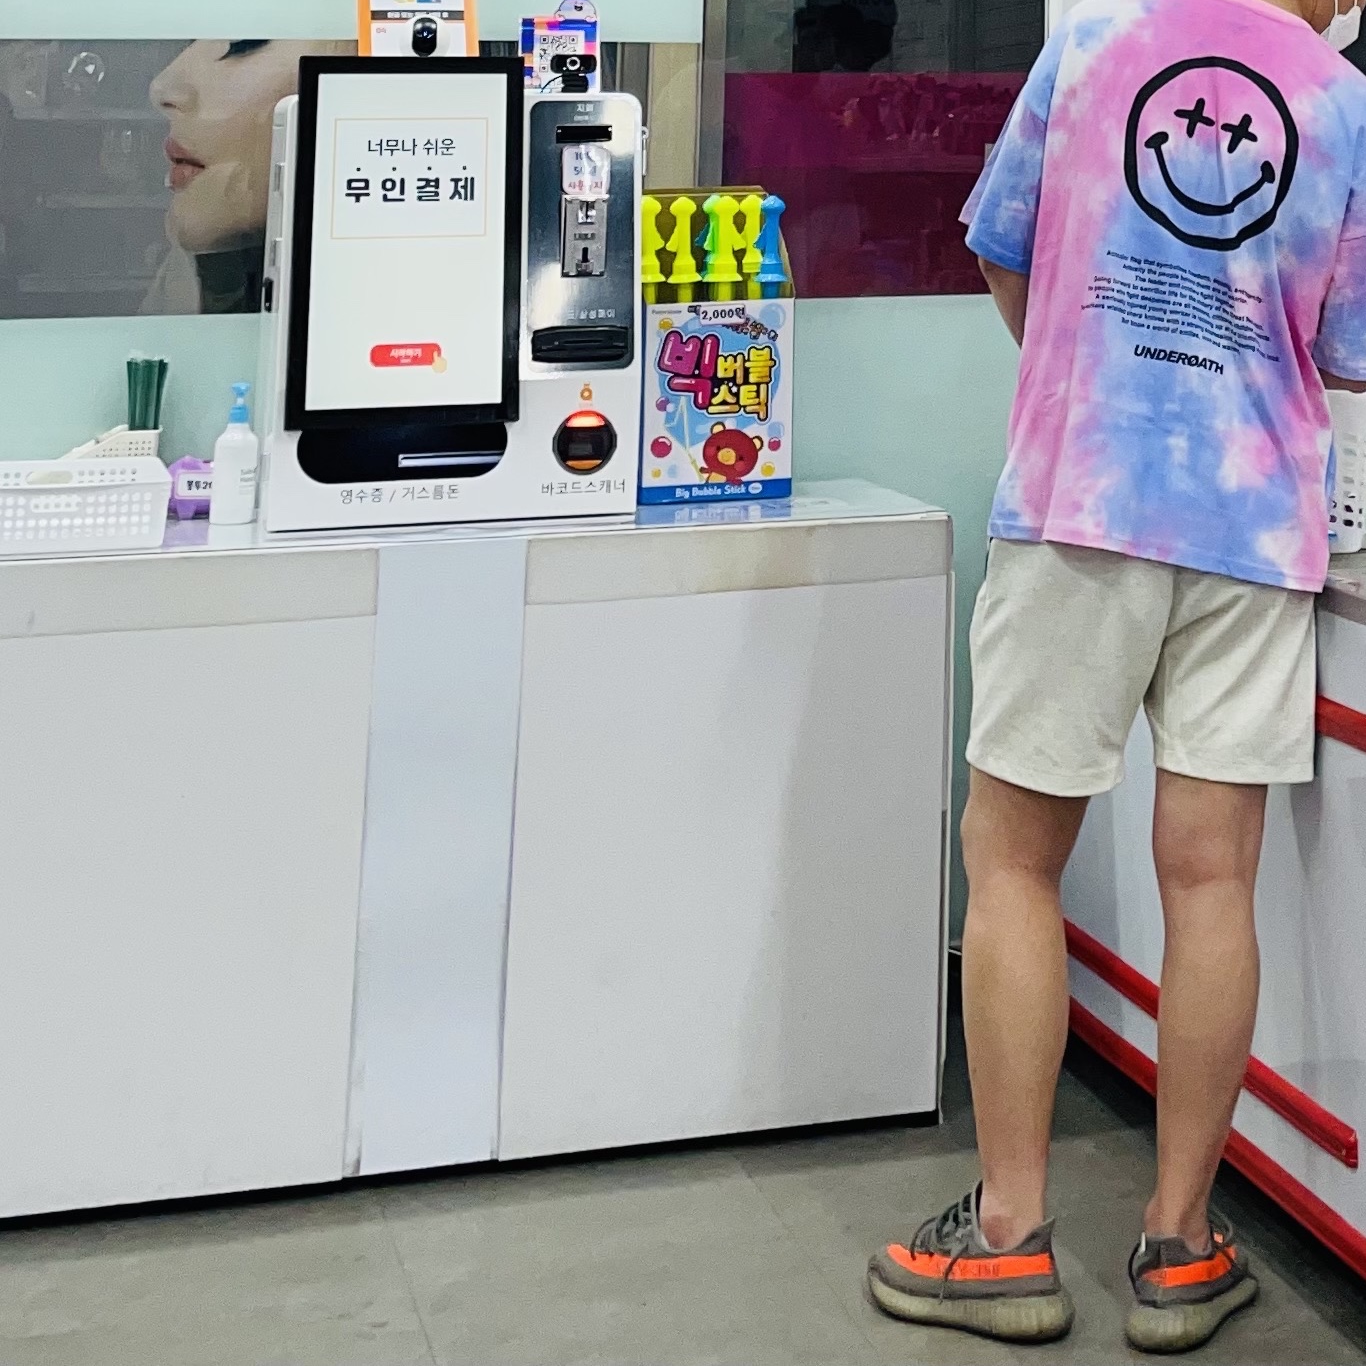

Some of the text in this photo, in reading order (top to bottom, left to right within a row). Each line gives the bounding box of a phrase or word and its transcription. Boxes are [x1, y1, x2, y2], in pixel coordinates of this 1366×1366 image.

[367, 137, 457, 157] 너무나 쉬운
[344, 176, 475, 204] 무인결제
[657, 329, 777, 411] 빅 버블
[706, 382, 770, 422] 스틱
[340, 488, 384, 505] 영수증
[402, 484, 460, 501] 거스름돈
[541, 479, 626, 496] 바코드스캐너
[675, 484, 747, 499] Big Bubble Stick
